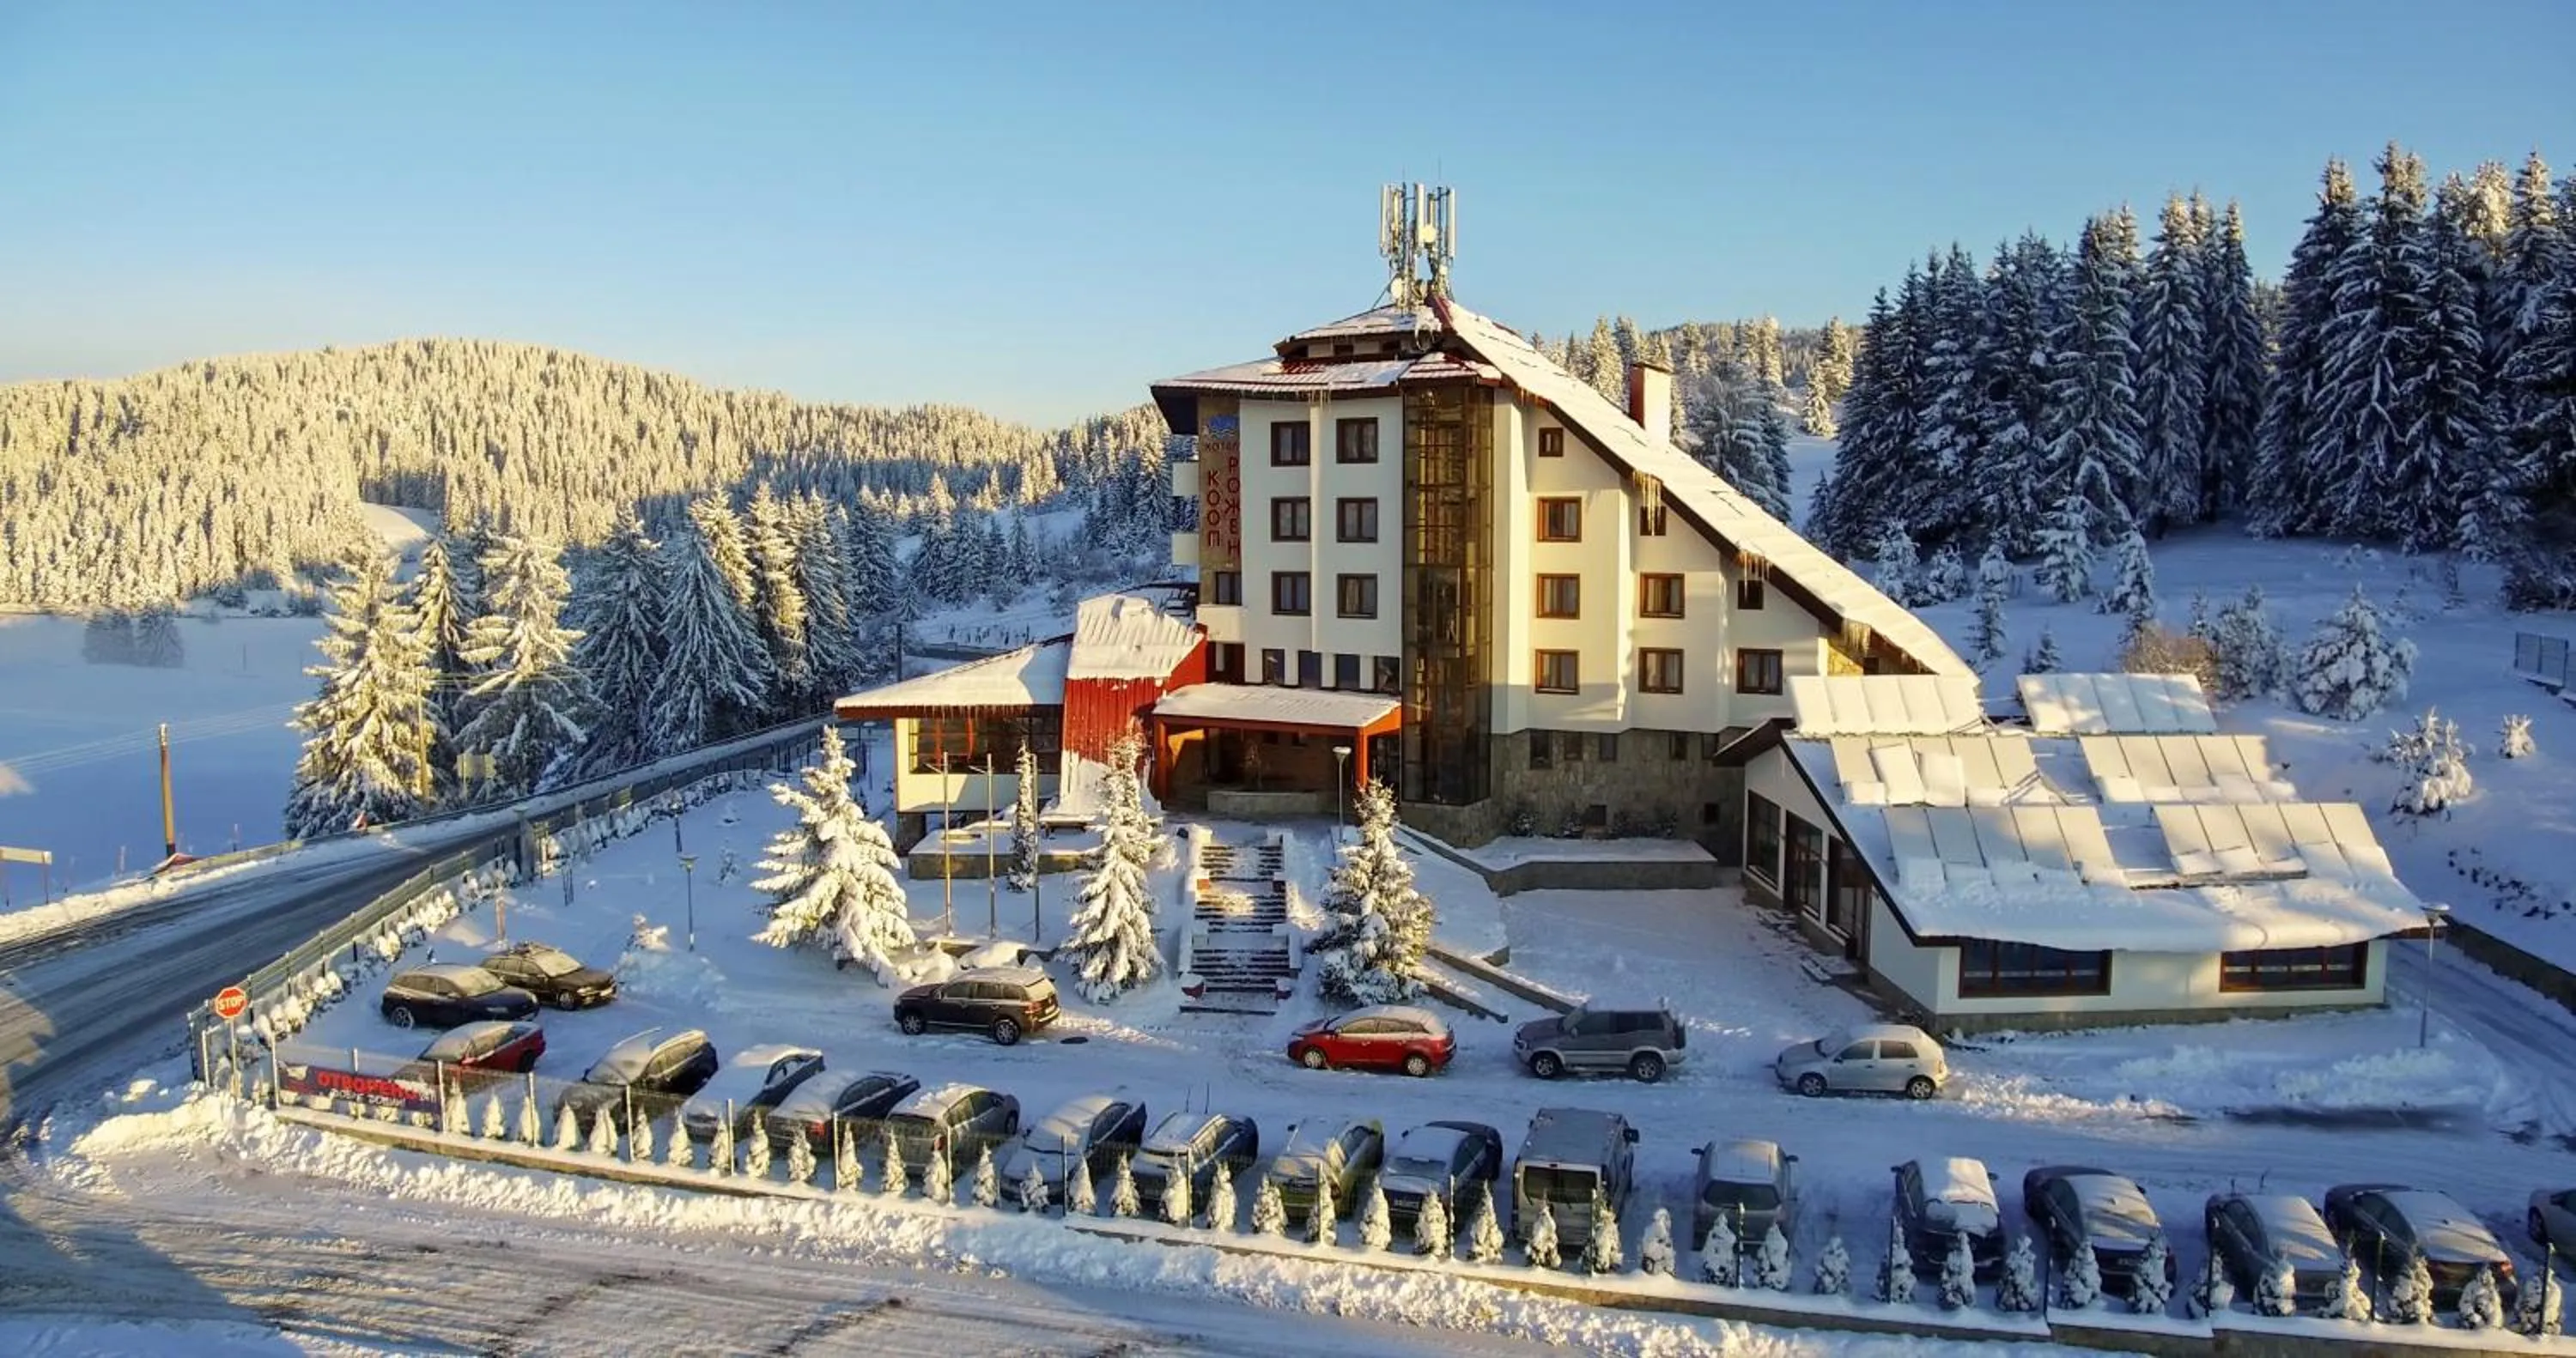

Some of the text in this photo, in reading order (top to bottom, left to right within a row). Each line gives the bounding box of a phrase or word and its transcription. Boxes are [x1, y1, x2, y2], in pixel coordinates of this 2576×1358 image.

[1206, 470, 1221, 547] КООП
[1224, 456, 1240, 558] РОЖЕН
[217, 996, 244, 1010] STOP
